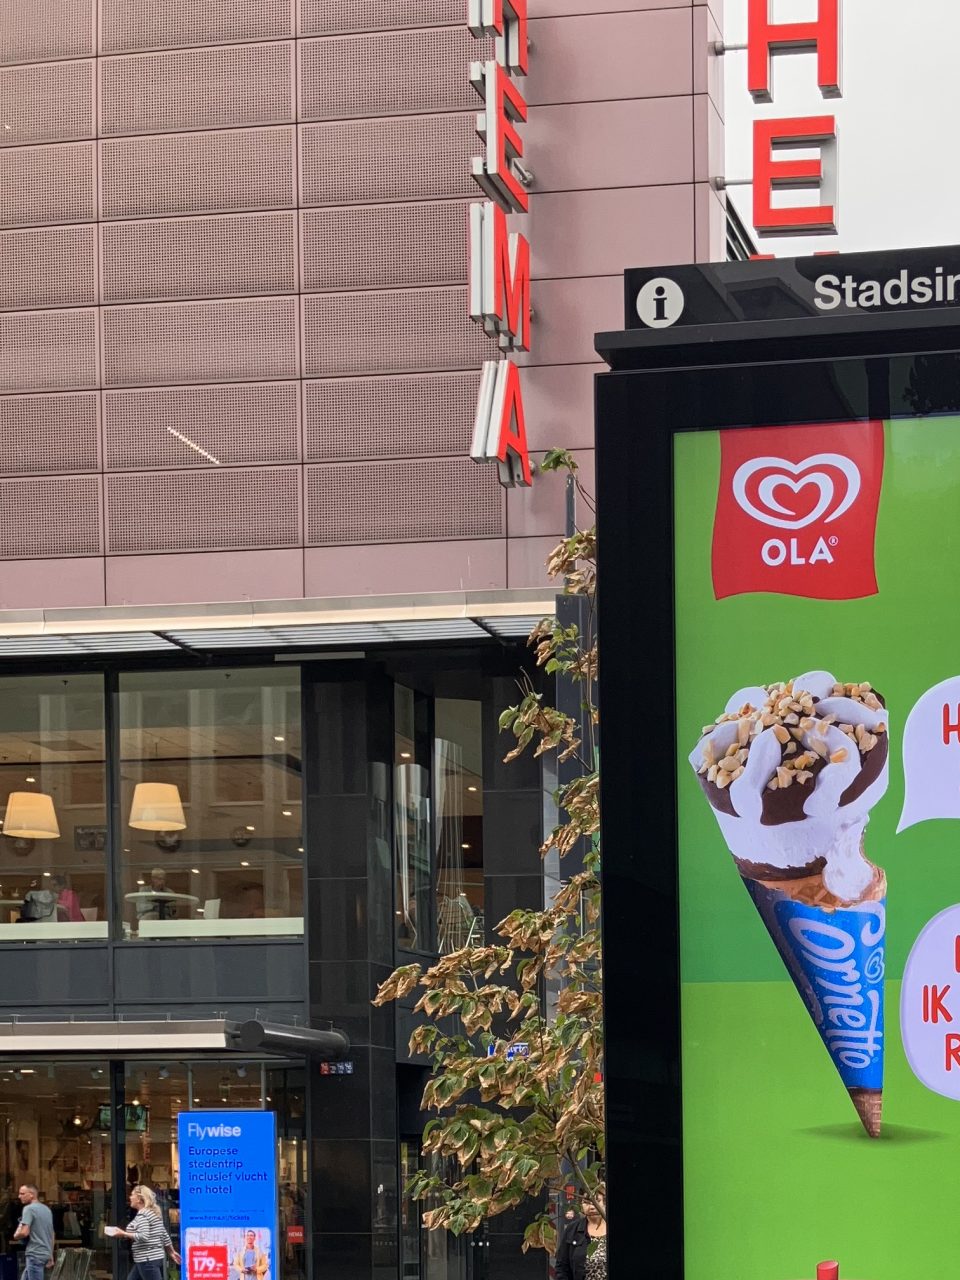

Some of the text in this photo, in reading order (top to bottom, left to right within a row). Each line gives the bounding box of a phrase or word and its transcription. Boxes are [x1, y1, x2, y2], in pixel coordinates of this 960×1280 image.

[748, 0, 842, 261] HE
[788, 900, 886, 1069] Cornetto
[922, 985, 953, 1022] IK
[187, 1122, 242, 1140] Flywise
[188, 1146, 238, 1157] Europese
[188, 1159, 243, 1170] stedentrip
[188, 1172, 268, 1181] inclusief vlucht
[189, 1184, 233, 1194] en hotel
